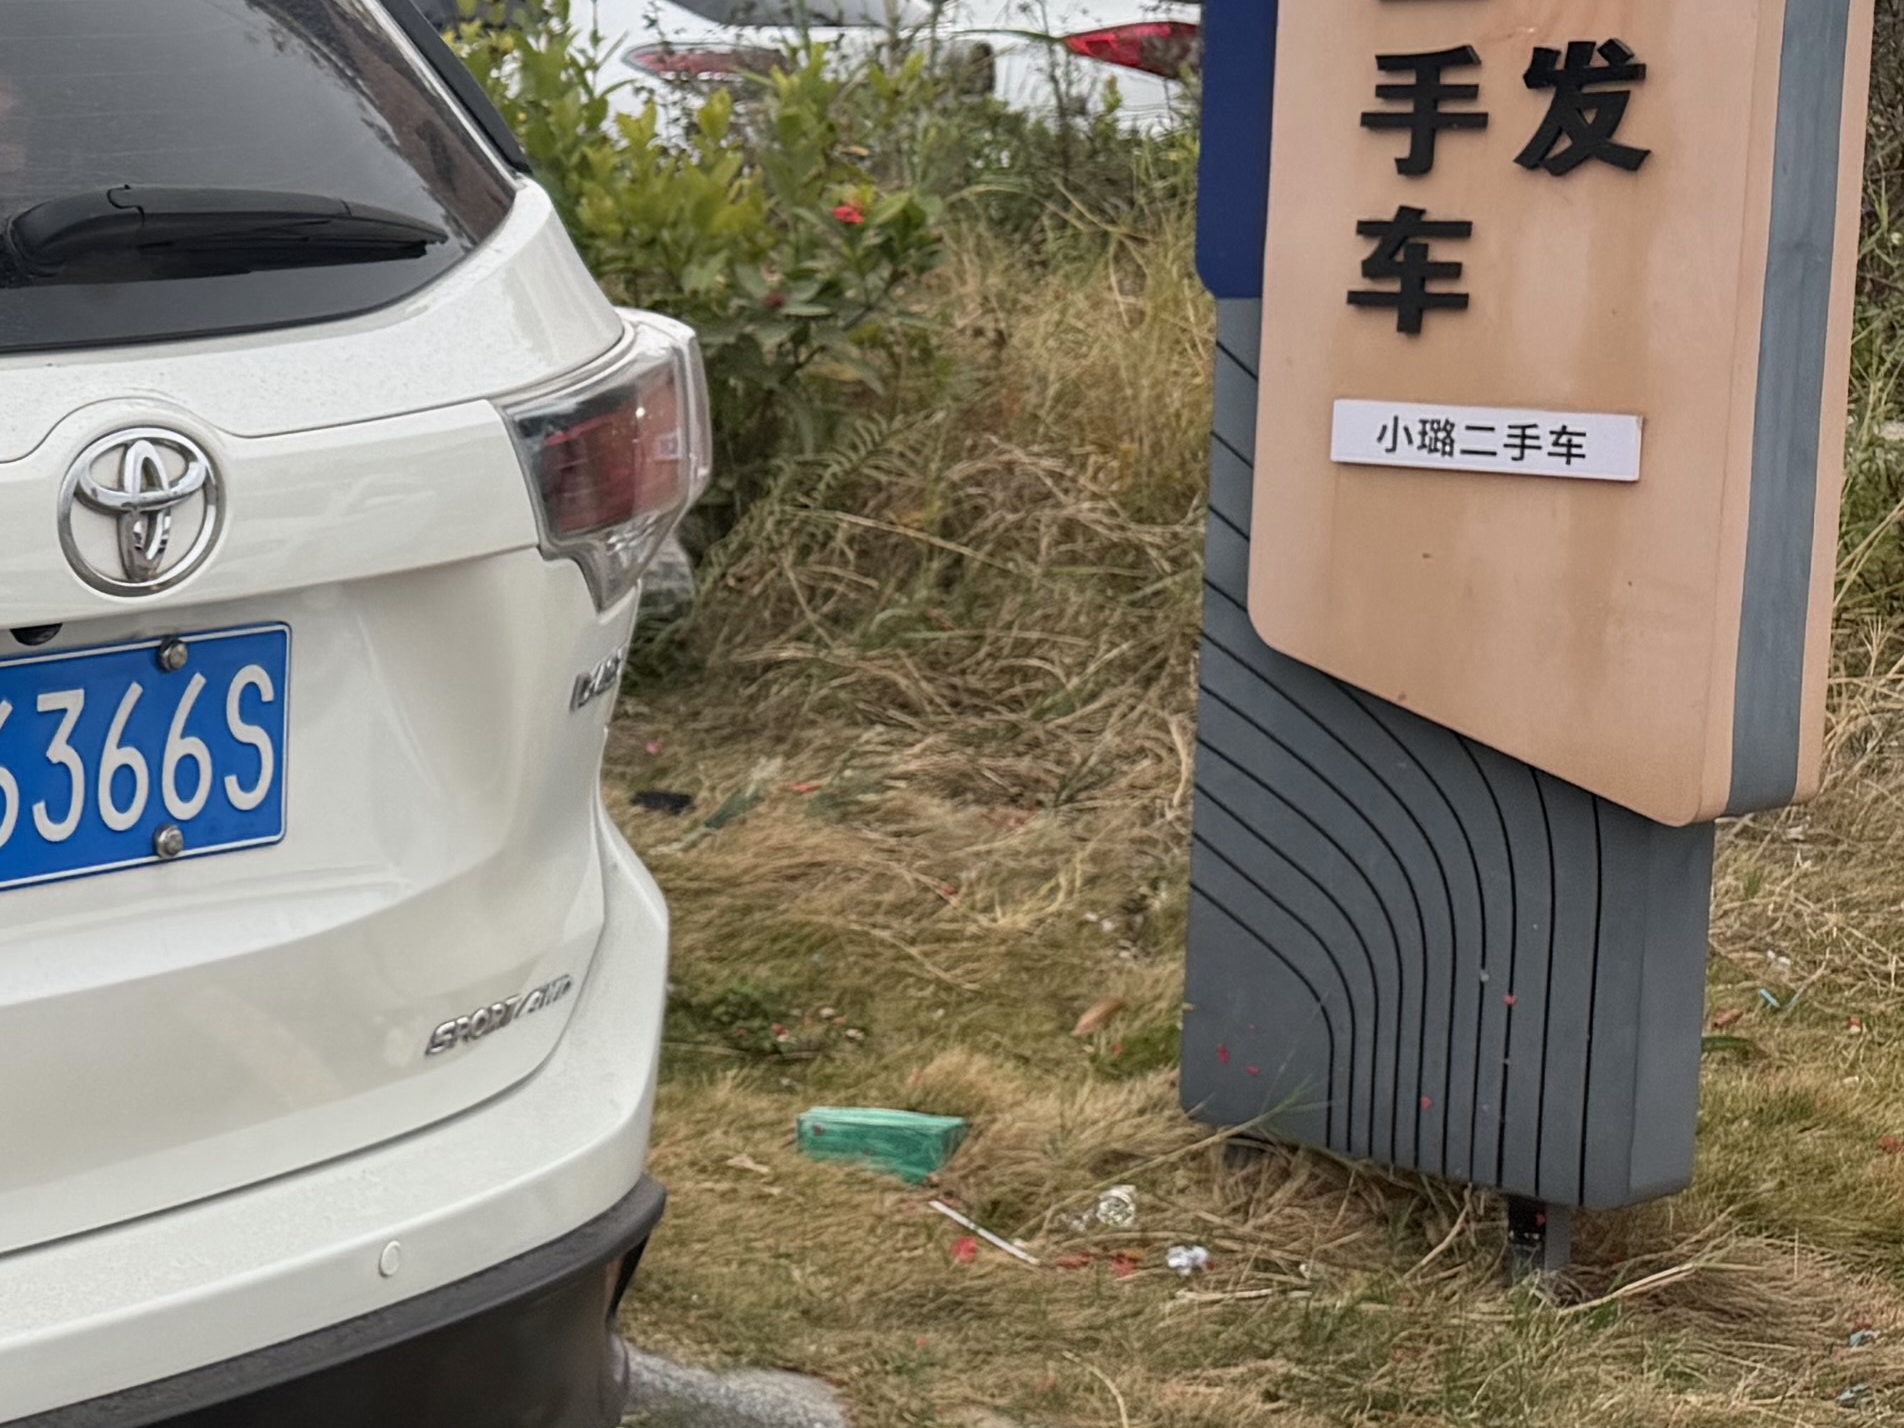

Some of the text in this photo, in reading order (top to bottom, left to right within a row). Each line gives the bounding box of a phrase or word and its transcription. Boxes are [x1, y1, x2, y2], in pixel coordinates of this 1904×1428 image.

[1376, 414, 1588, 466] 小璐二手车
